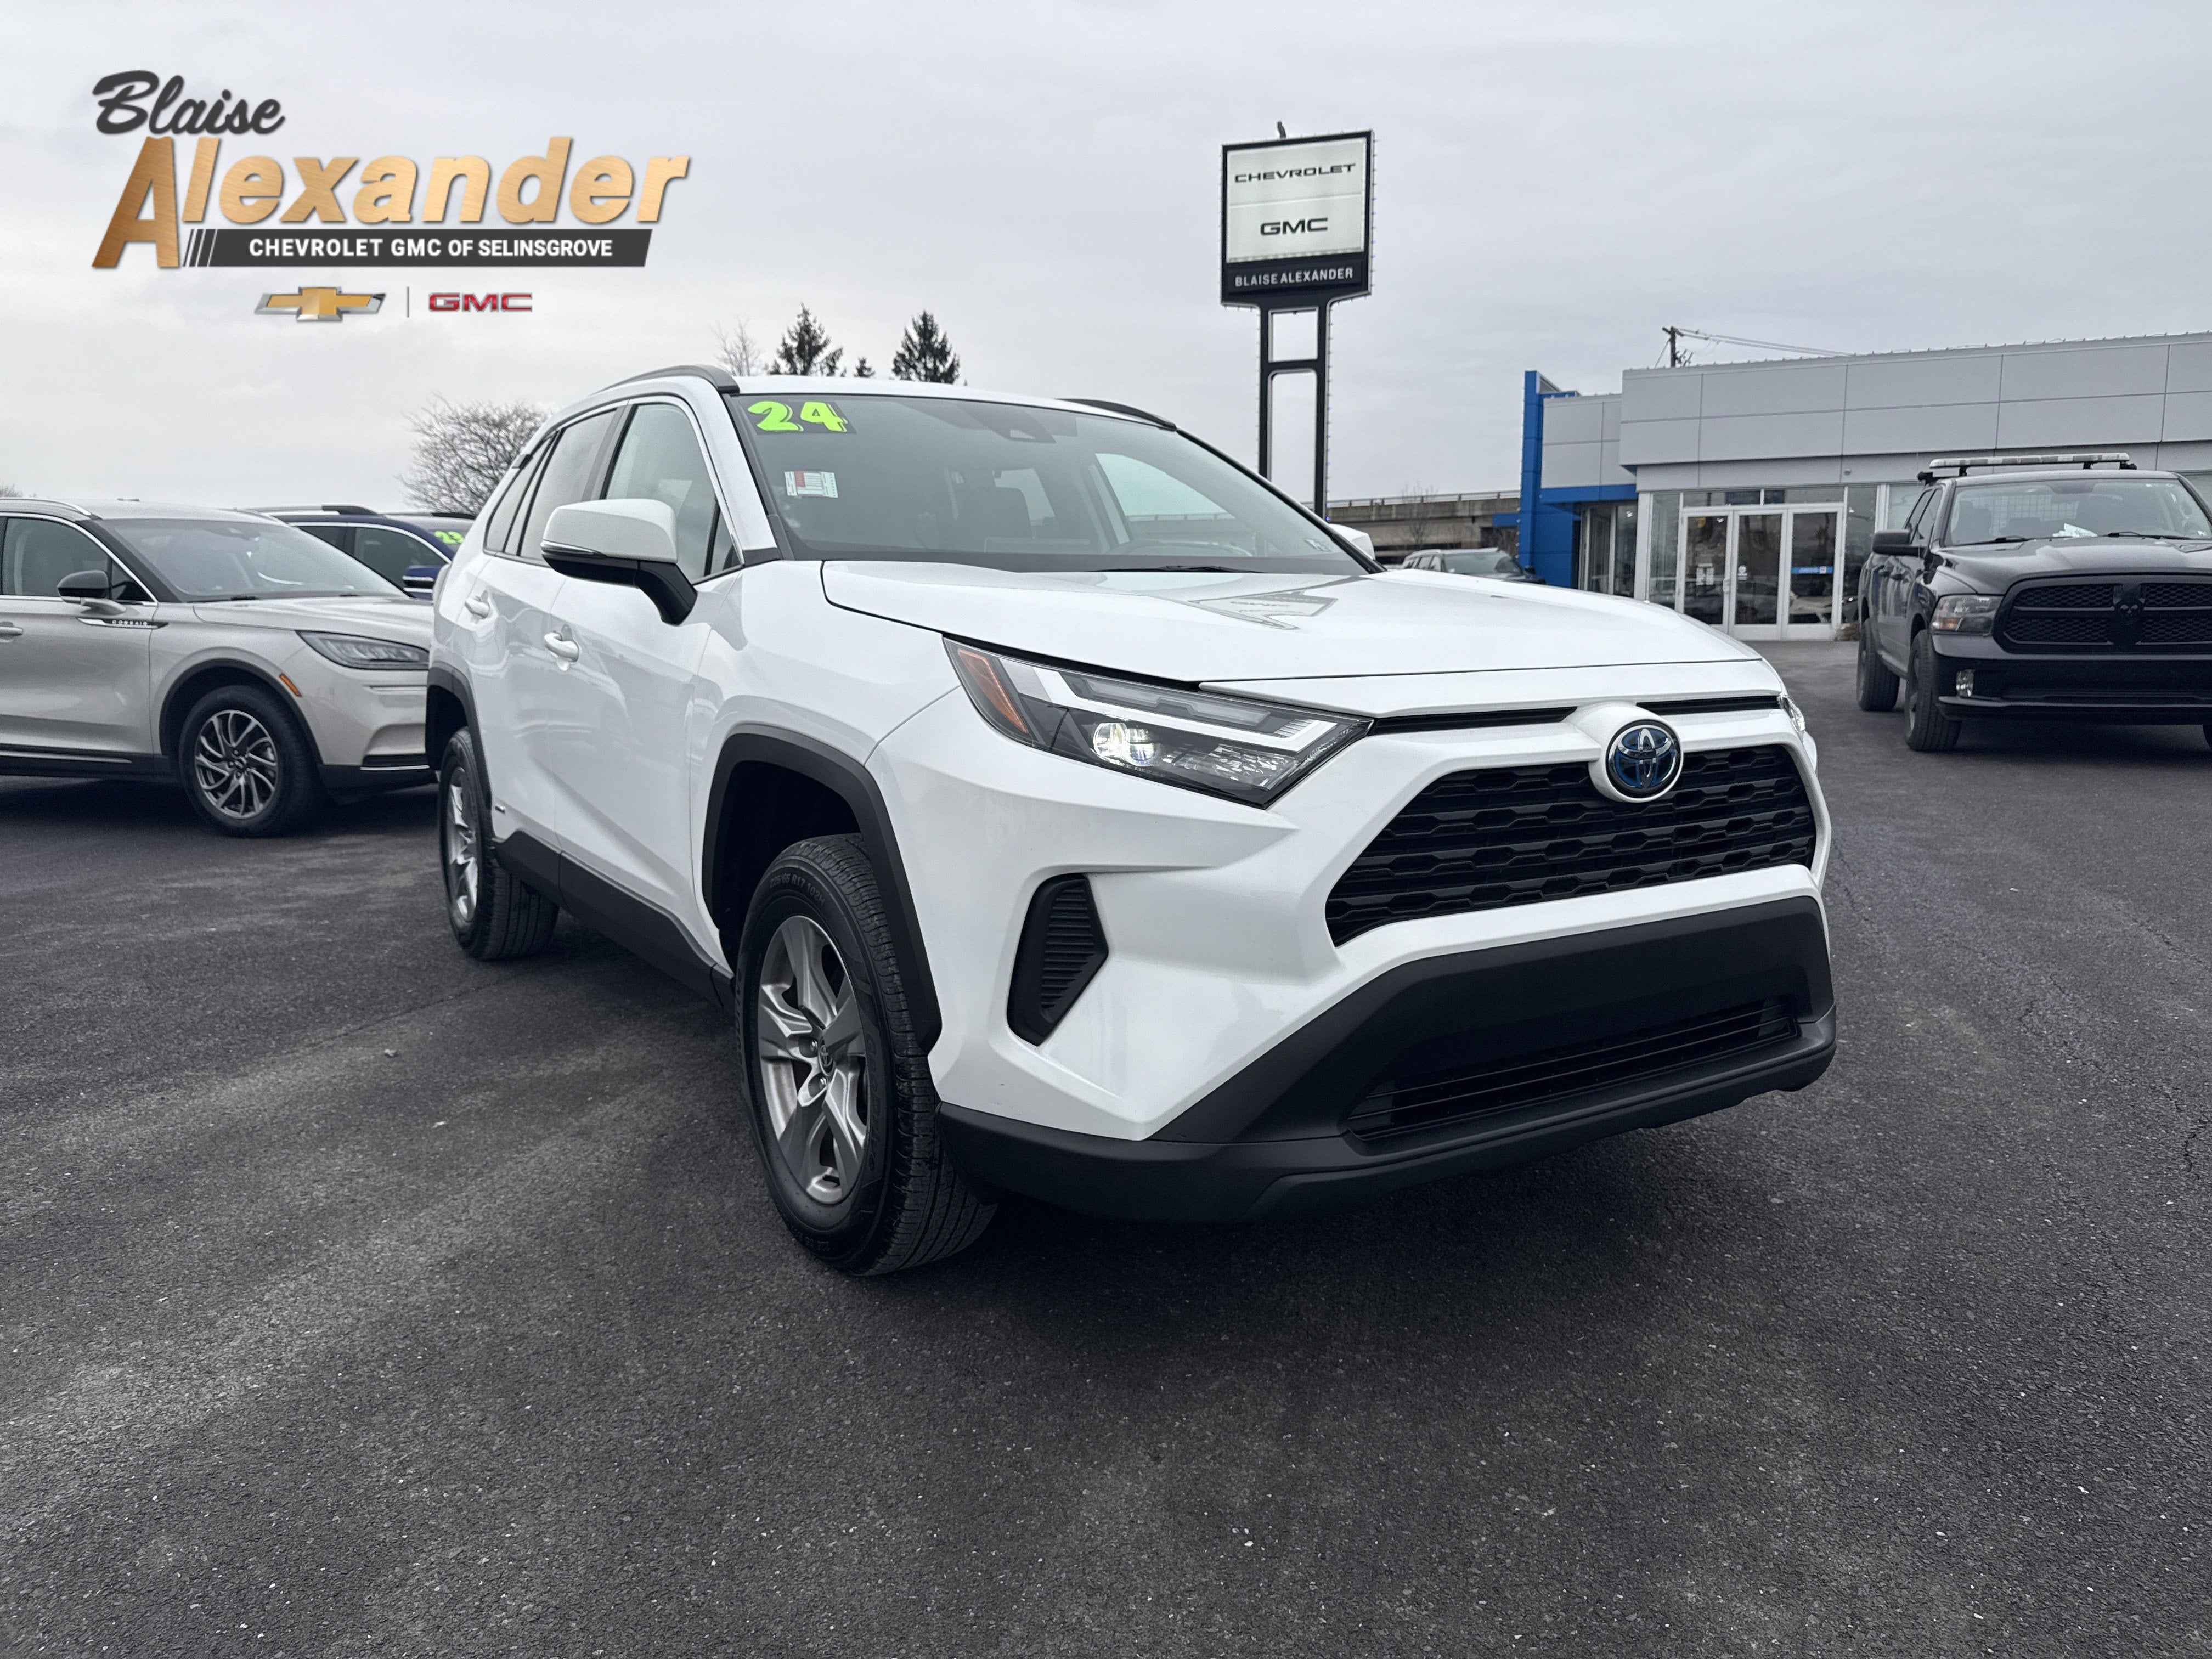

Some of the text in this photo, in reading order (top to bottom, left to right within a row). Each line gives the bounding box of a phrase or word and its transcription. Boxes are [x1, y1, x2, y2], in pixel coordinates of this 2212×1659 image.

[1234, 163, 1356, 183] CHEVROLET
[1260, 217, 1328, 236] GMC
[1235, 267, 1353, 287] BLAISE ALEXANDER
[747, 400, 848, 432] 24
